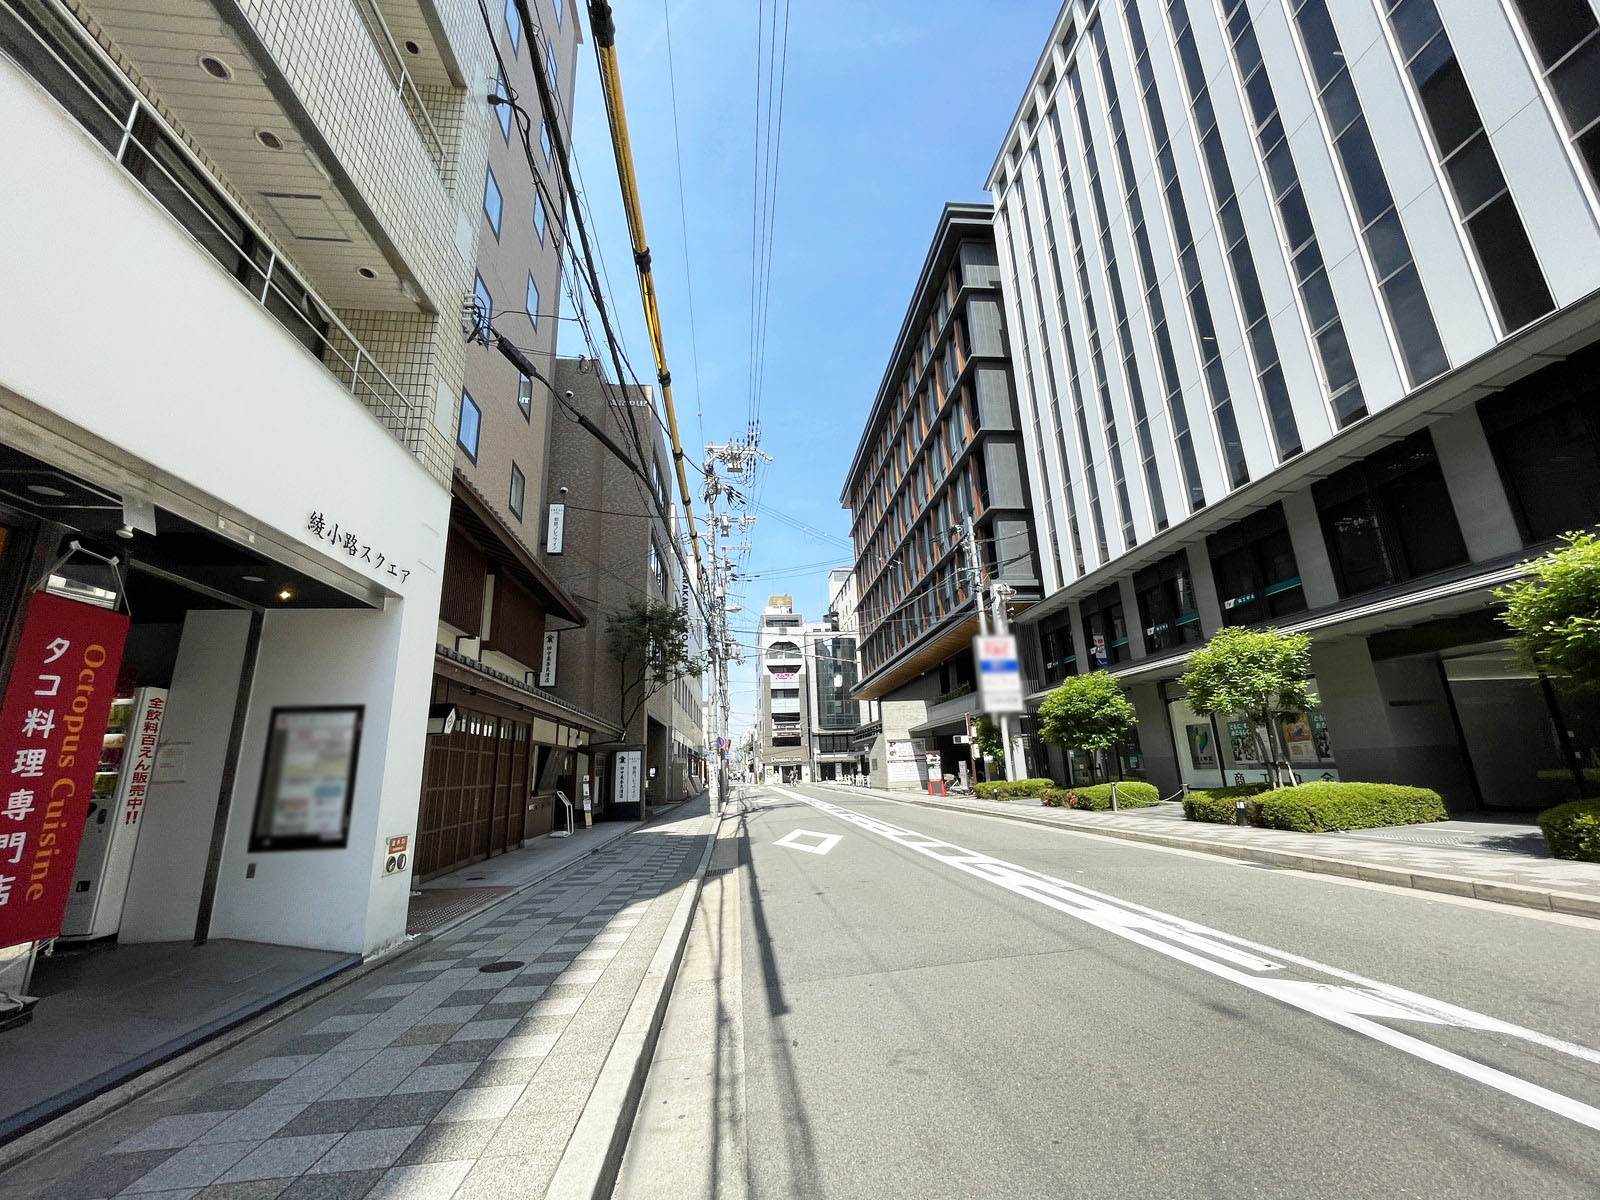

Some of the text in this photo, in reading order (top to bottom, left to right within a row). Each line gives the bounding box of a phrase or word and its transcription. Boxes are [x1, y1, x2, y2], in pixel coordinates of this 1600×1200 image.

[307, 511, 410, 584] 綾小路スクエア
[26, 644, 106, 904] Octopus Cuisine
